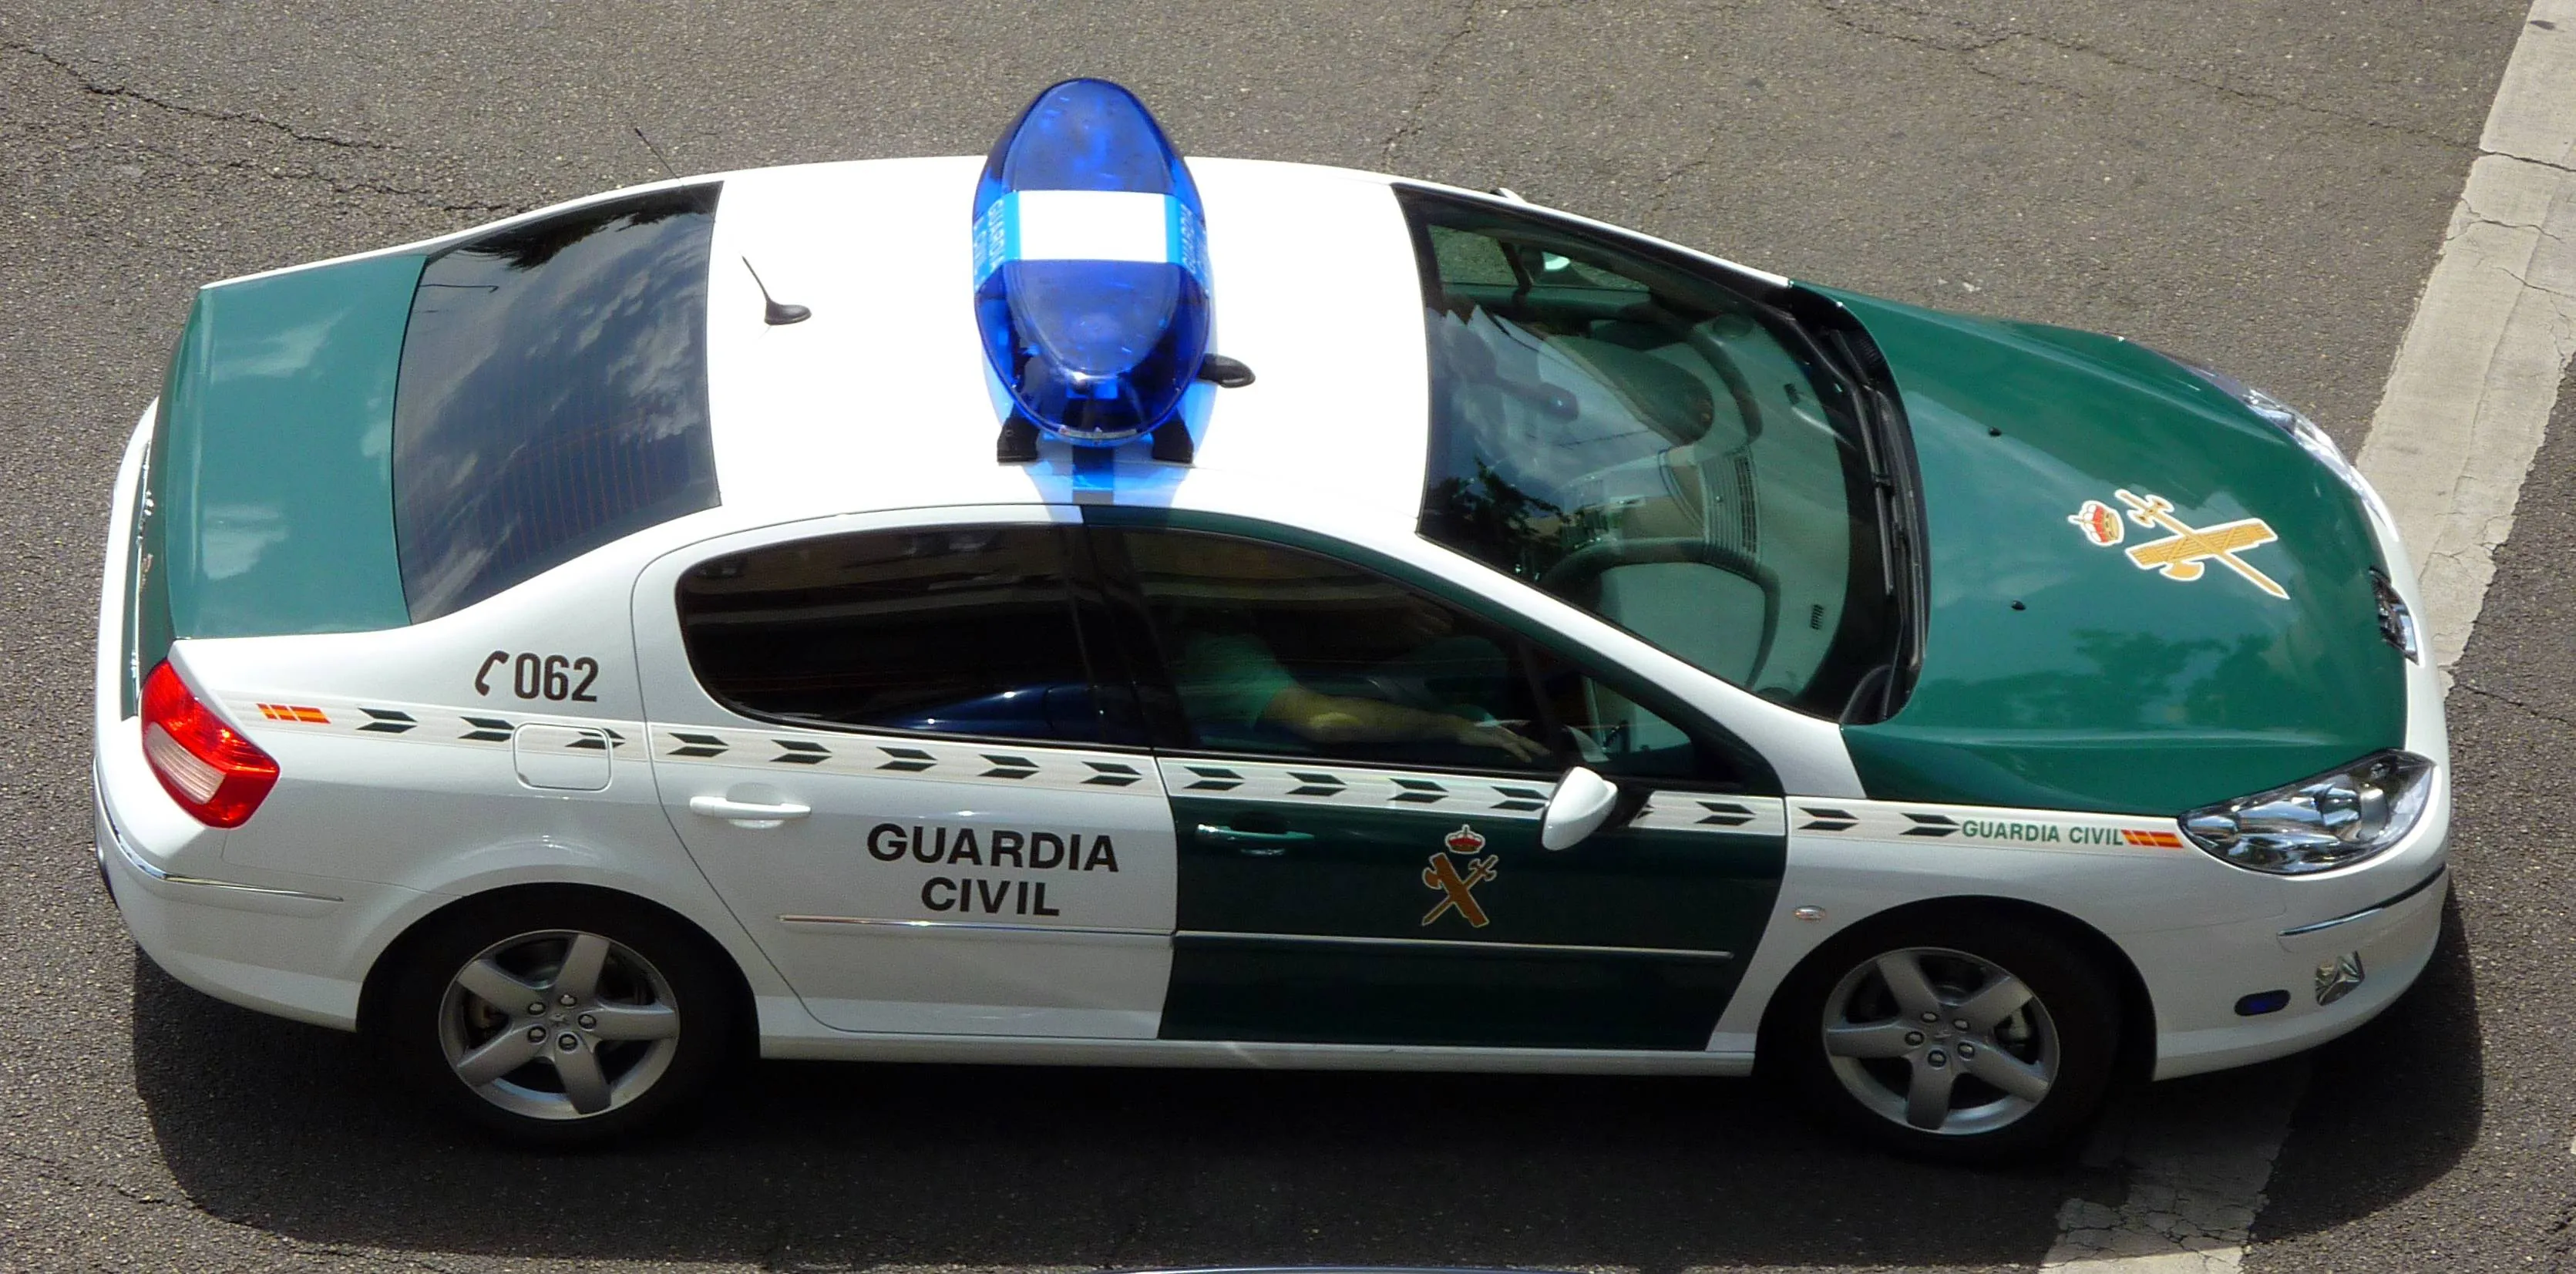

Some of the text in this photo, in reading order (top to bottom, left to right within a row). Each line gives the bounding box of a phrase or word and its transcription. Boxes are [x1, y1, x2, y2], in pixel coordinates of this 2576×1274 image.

[988, 199, 1005, 274] GUARDIA
[1180, 203, 1196, 274] GUARDIA
[514, 652, 599, 702] 062
[867, 822, 1119, 872] GUARDIA
[1962, 820, 2124, 845] GUARDIA CIVIL
[921, 876, 1060, 916] CIVIL
